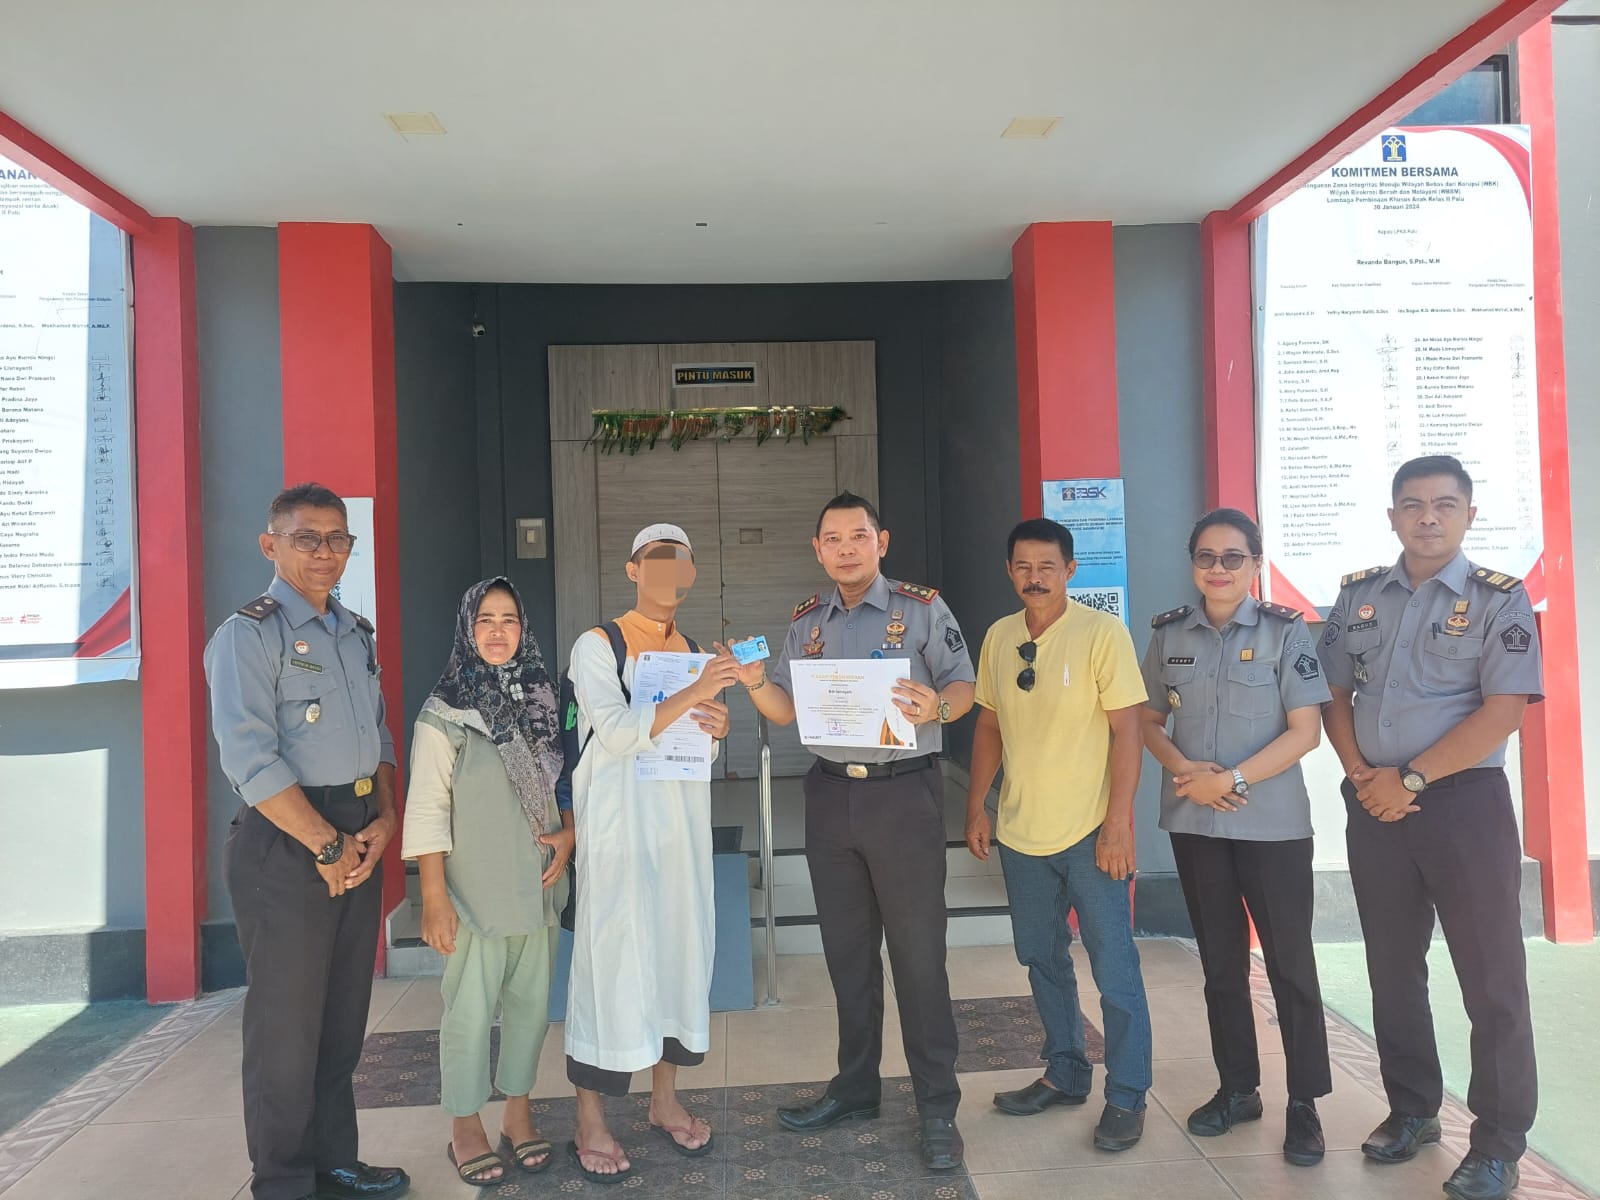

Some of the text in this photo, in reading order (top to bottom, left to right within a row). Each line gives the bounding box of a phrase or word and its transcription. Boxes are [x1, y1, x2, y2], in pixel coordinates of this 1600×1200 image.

[1331, 166, 1460, 178] KOMITMEN BERSAMA
[677, 370, 752, 382] PINTU MASUK
